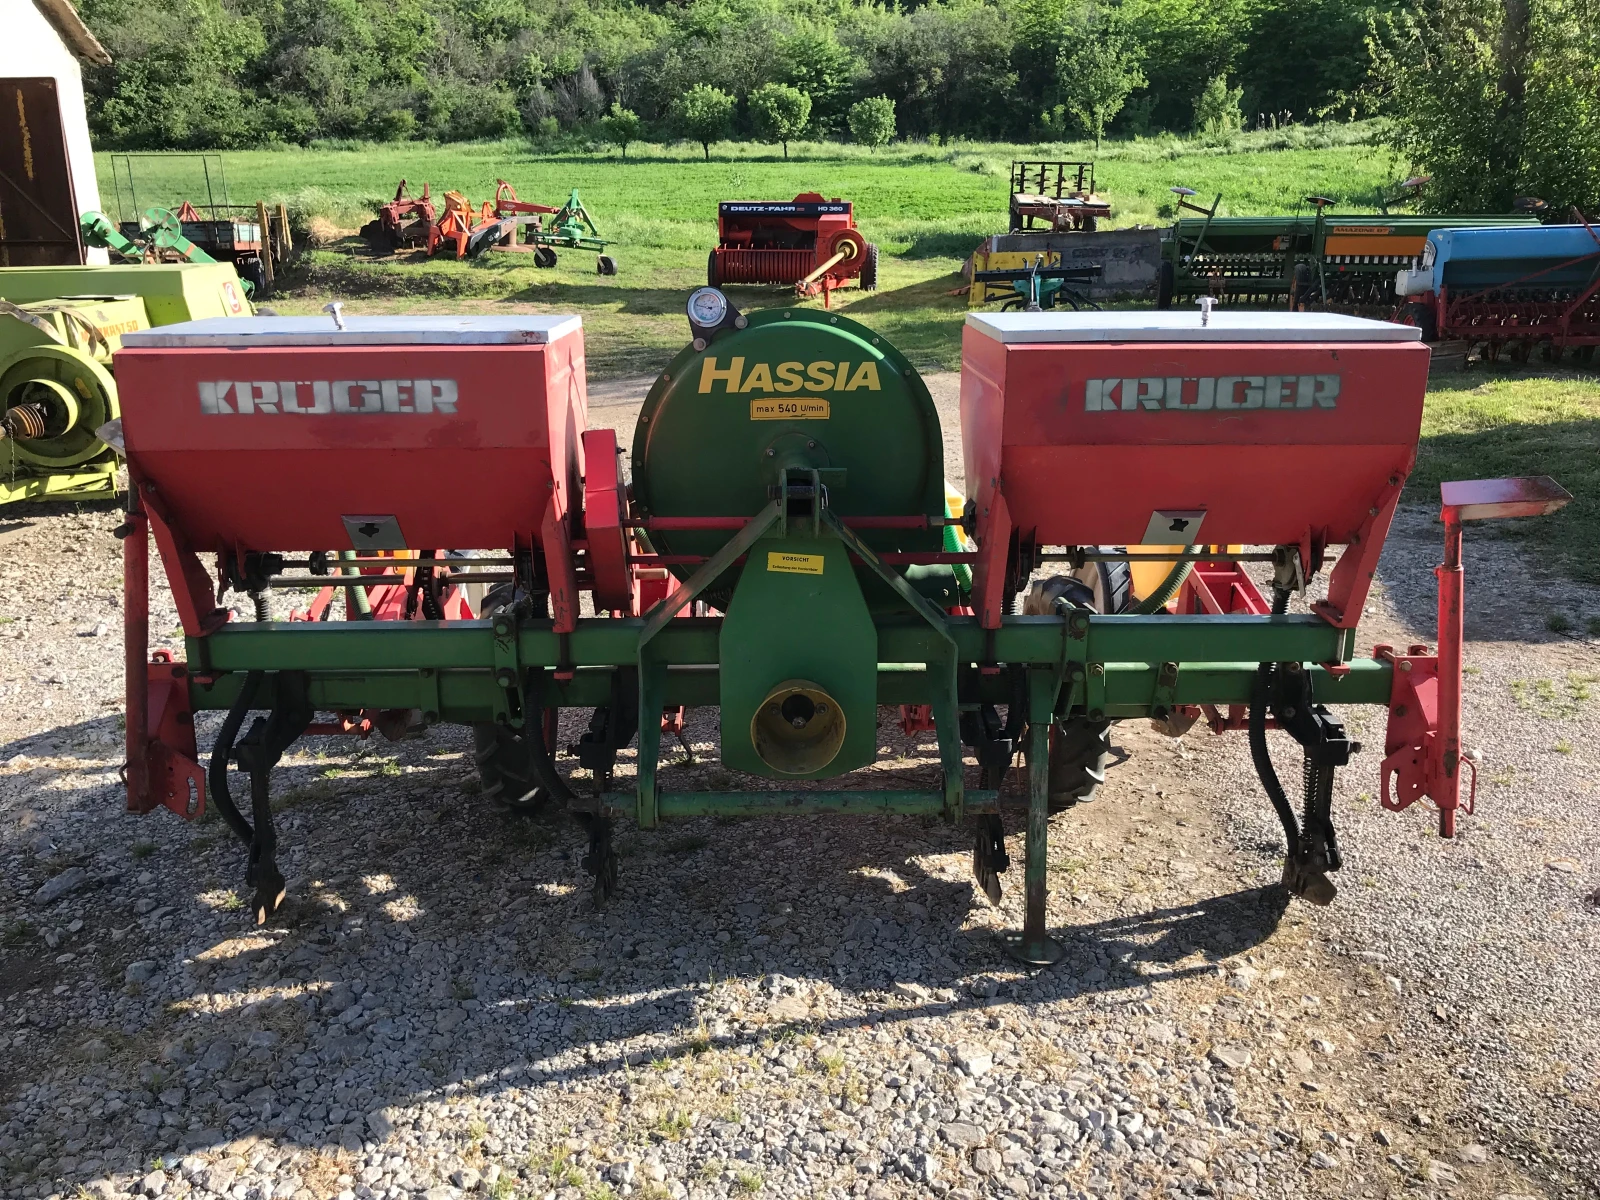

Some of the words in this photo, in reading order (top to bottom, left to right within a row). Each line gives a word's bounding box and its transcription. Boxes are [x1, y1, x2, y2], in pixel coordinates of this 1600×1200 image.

[80, 322, 127, 343] MKANT
[126, 320, 139, 333] 50
[698, 357, 881, 394] HASSIA
[1085, 374, 1341, 411] KRÜGER
[198, 379, 459, 414] KRÜGER
[778, 404, 798, 413] 540
[800, 404, 824, 412] U/min
